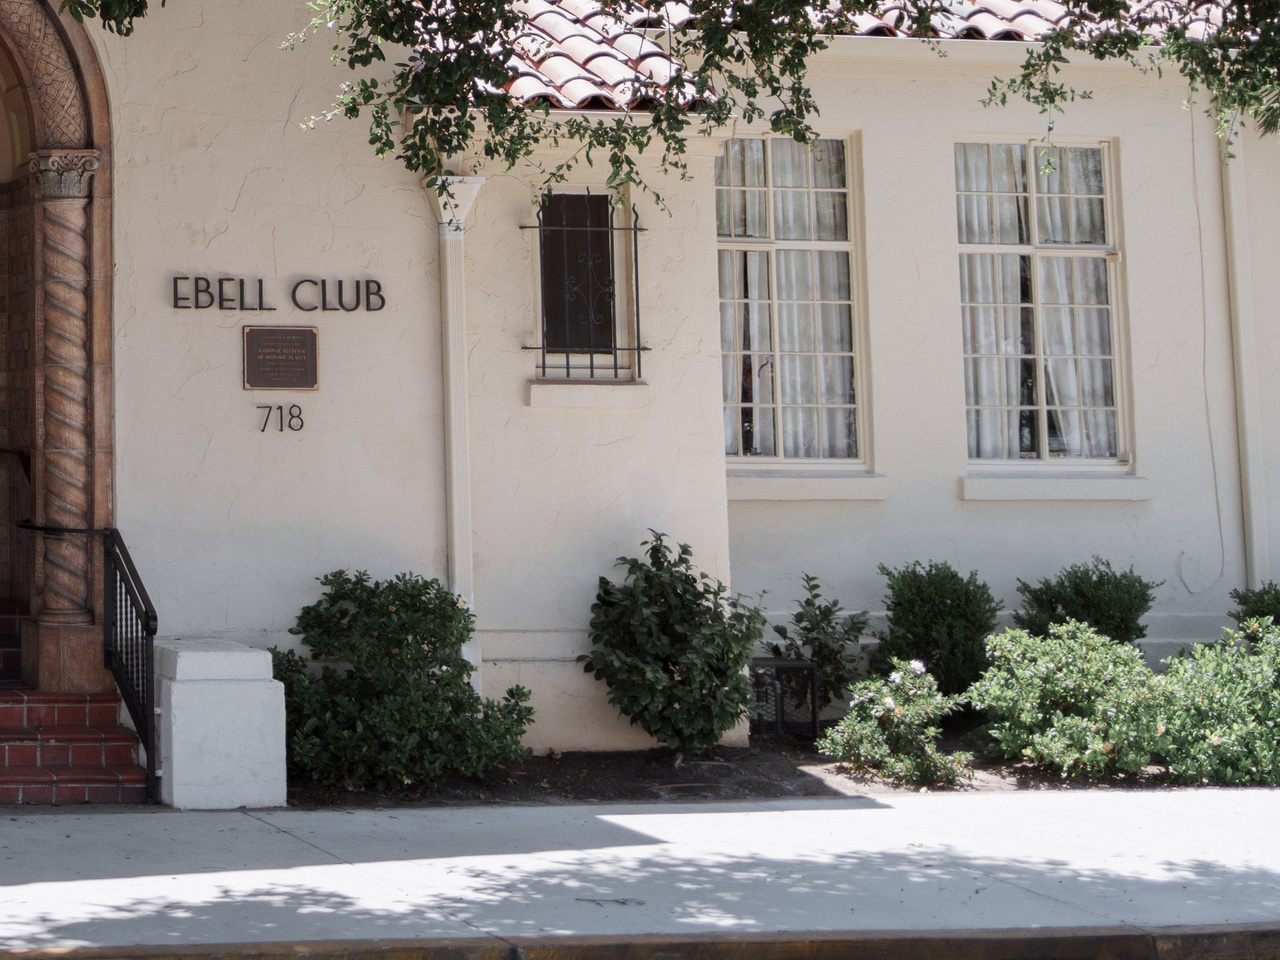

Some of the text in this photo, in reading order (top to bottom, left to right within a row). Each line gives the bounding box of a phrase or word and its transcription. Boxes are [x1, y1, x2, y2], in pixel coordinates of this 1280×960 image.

[173, 277, 386, 312] EBELL CLUB
[256, 404, 304, 432] 718
